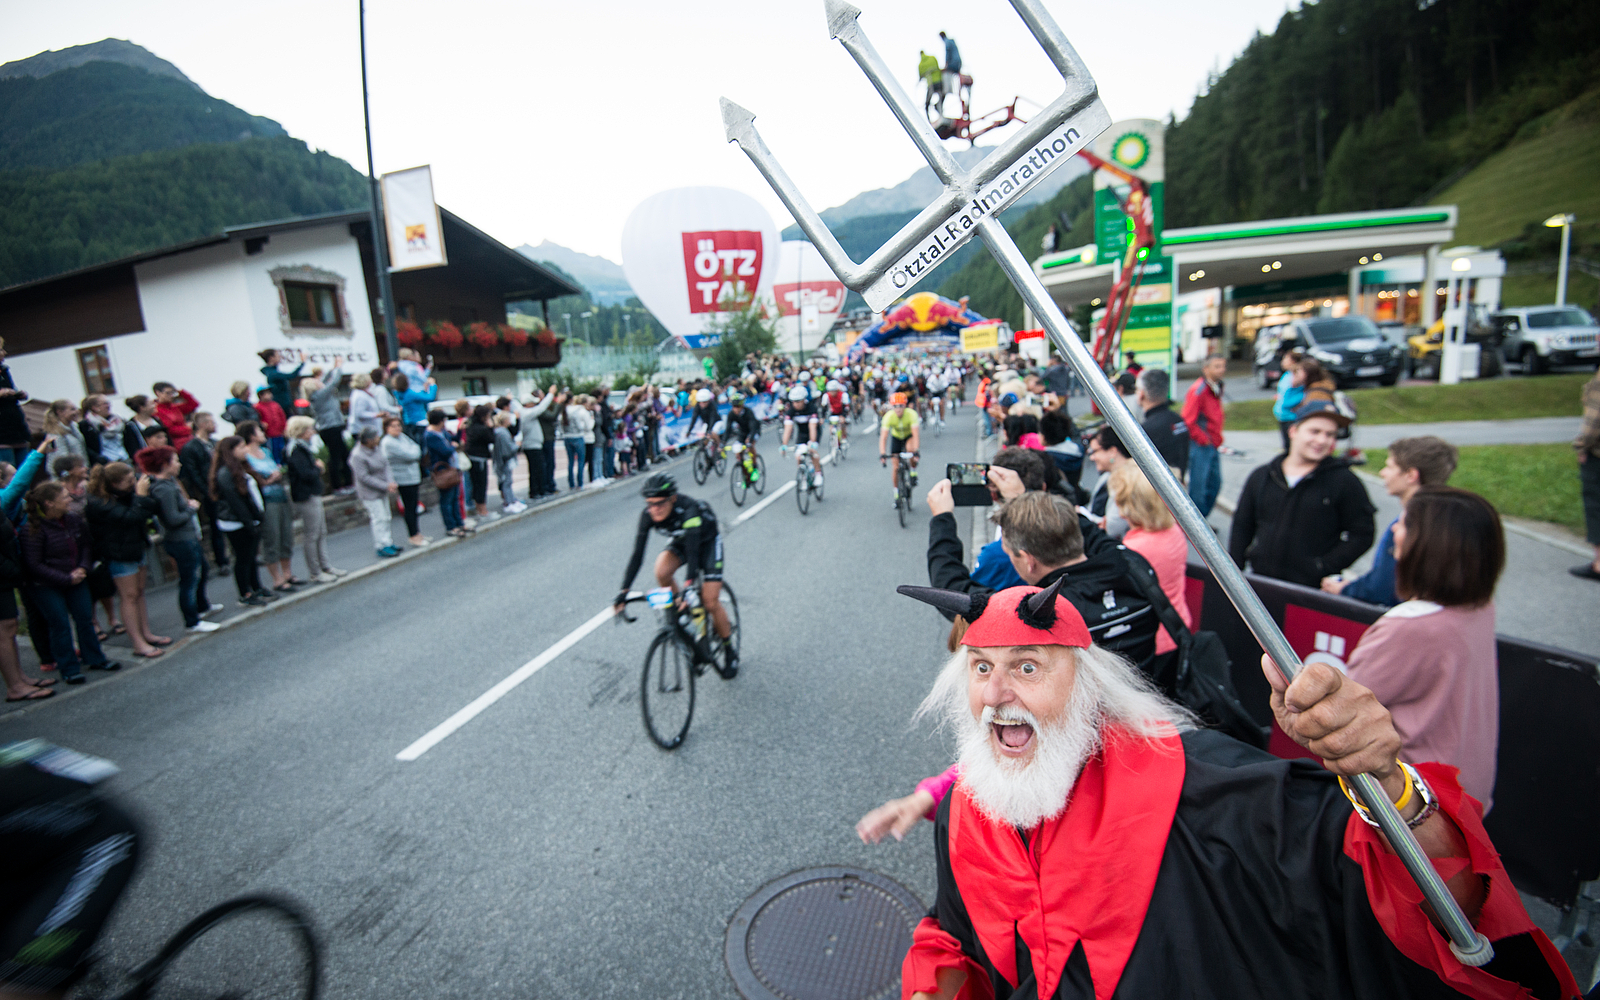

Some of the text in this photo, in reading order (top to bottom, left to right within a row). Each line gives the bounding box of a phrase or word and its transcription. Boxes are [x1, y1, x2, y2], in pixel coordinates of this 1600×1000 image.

[891, 125, 1081, 289] Ötztal-Radmarathon
[694, 239, 757, 278] ÖTZ
[695, 280, 750, 305] TAL
